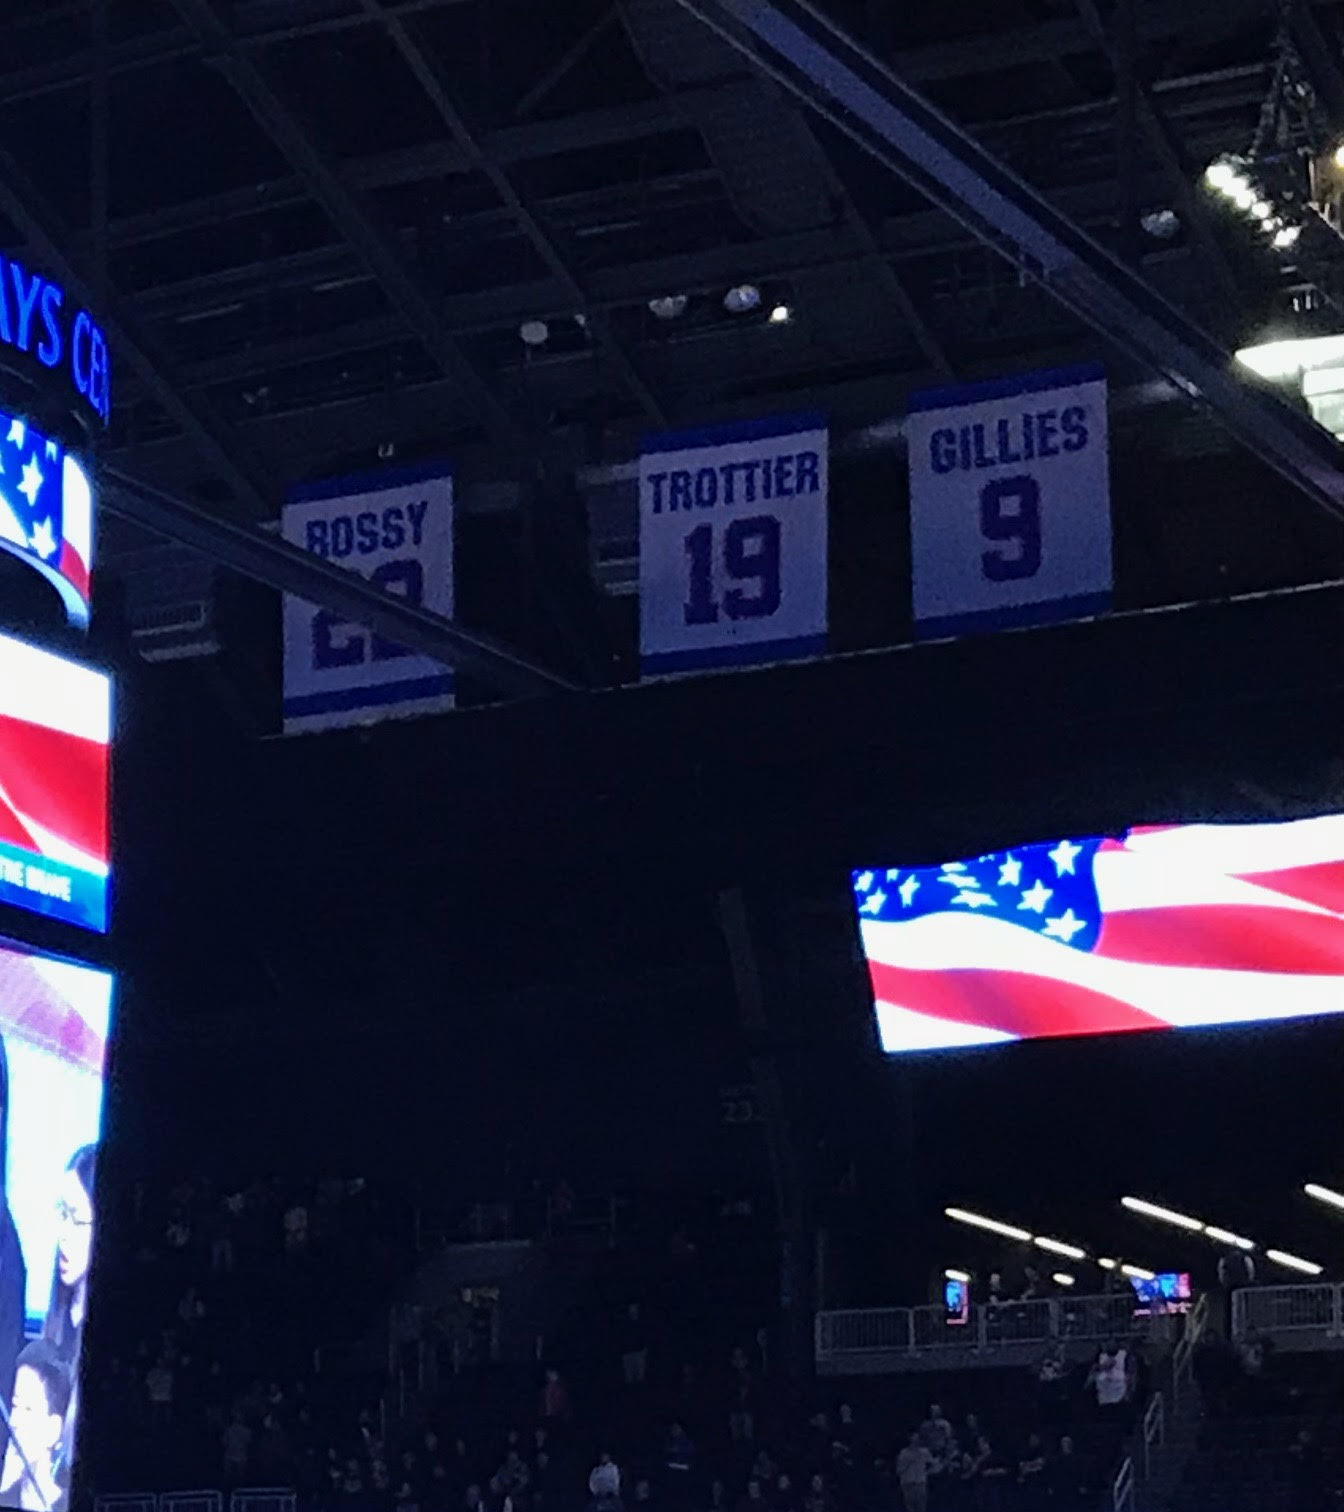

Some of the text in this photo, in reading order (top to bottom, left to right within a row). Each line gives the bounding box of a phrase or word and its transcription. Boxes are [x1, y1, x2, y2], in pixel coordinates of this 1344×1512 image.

[929, 405, 1089, 474] GILLIES
[647, 451, 820, 515] TROTTIER
[306, 501, 428, 559] BOSSY
[978, 473, 1043, 583] 9
[683, 515, 783, 626] 19
